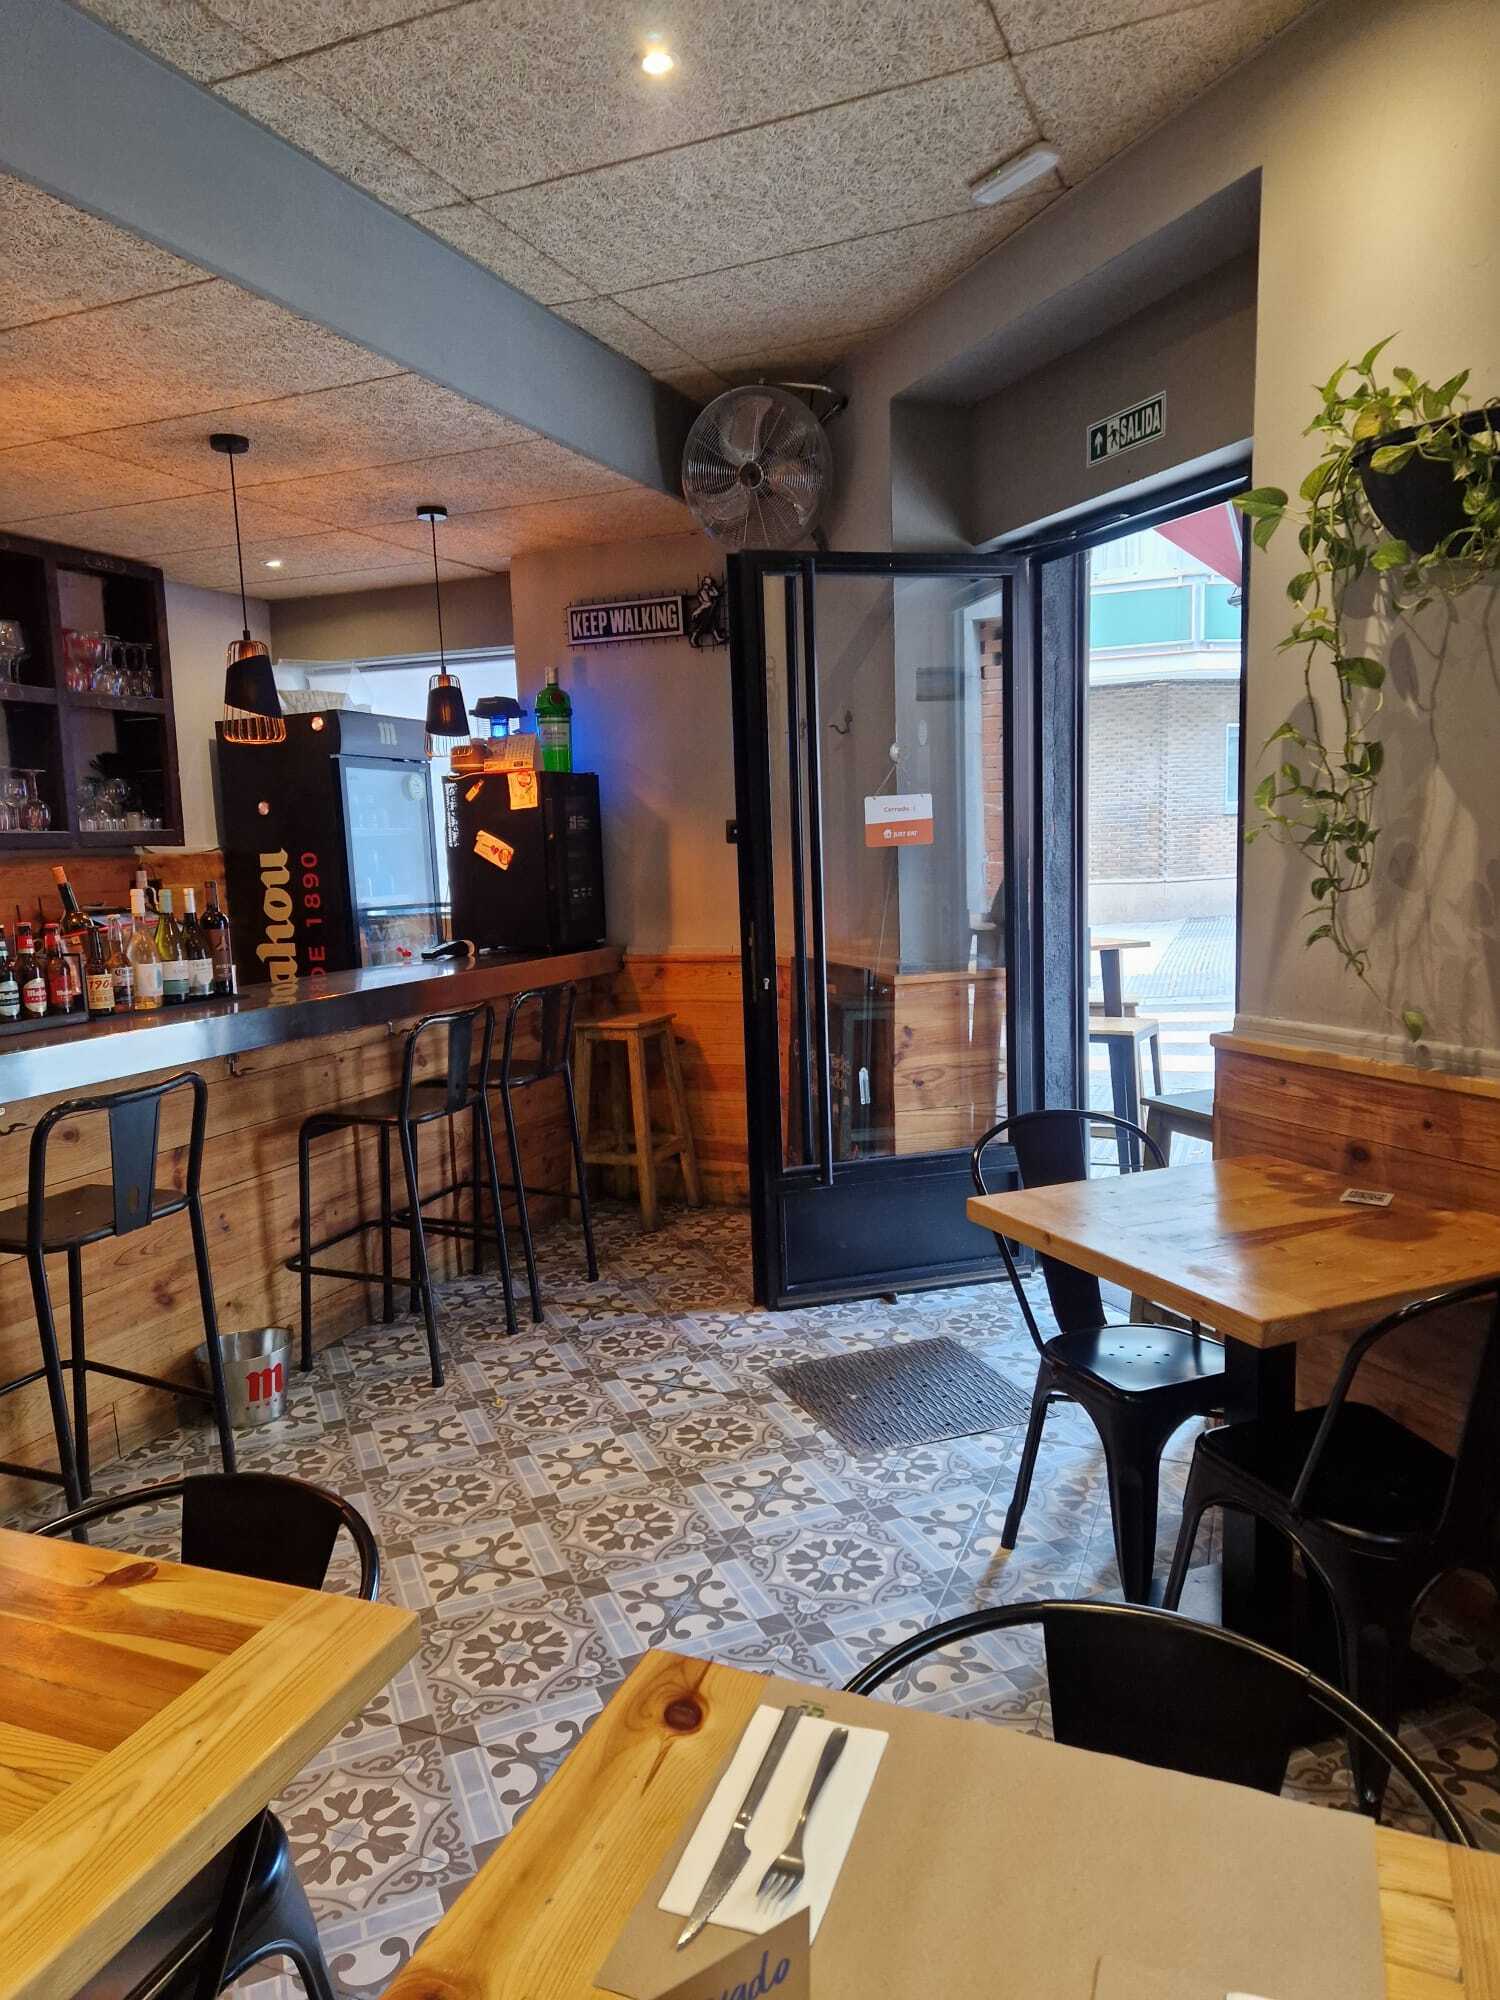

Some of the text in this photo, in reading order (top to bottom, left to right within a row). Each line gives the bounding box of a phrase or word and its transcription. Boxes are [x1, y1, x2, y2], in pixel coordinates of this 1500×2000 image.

[1120, 403, 1161, 445] SALIDA
[572, 603, 678, 638] KEEP WALKING
[256, 848, 298, 984] ahou
[301, 852, 323, 928] 1890
